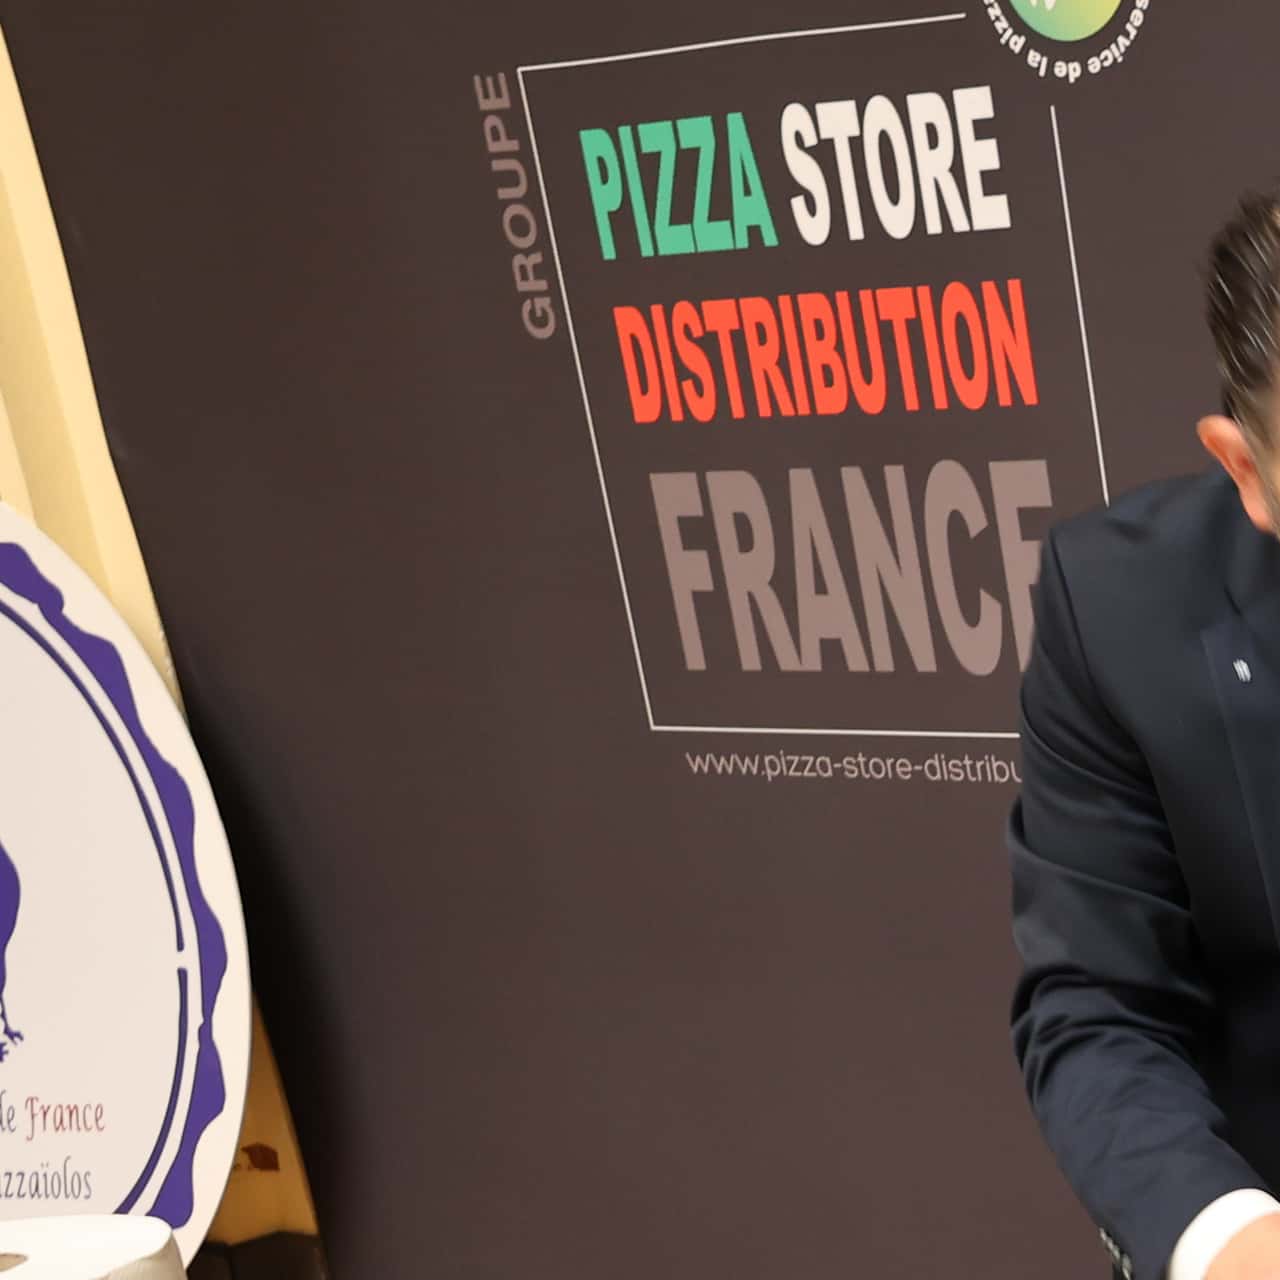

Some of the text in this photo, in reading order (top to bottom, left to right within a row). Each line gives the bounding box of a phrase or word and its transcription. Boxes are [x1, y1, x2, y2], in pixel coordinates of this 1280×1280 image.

[983, 0, 1149, 84] service de la pizz
[473, 71, 557, 340] GROUPE
[579, 85, 1012, 261] PIZZA STORE
[612, 278, 1039, 425] DISTRIBUTION
[25, 1096, 105, 1142] France
[0, 1154, 93, 1200] zzaïolos
